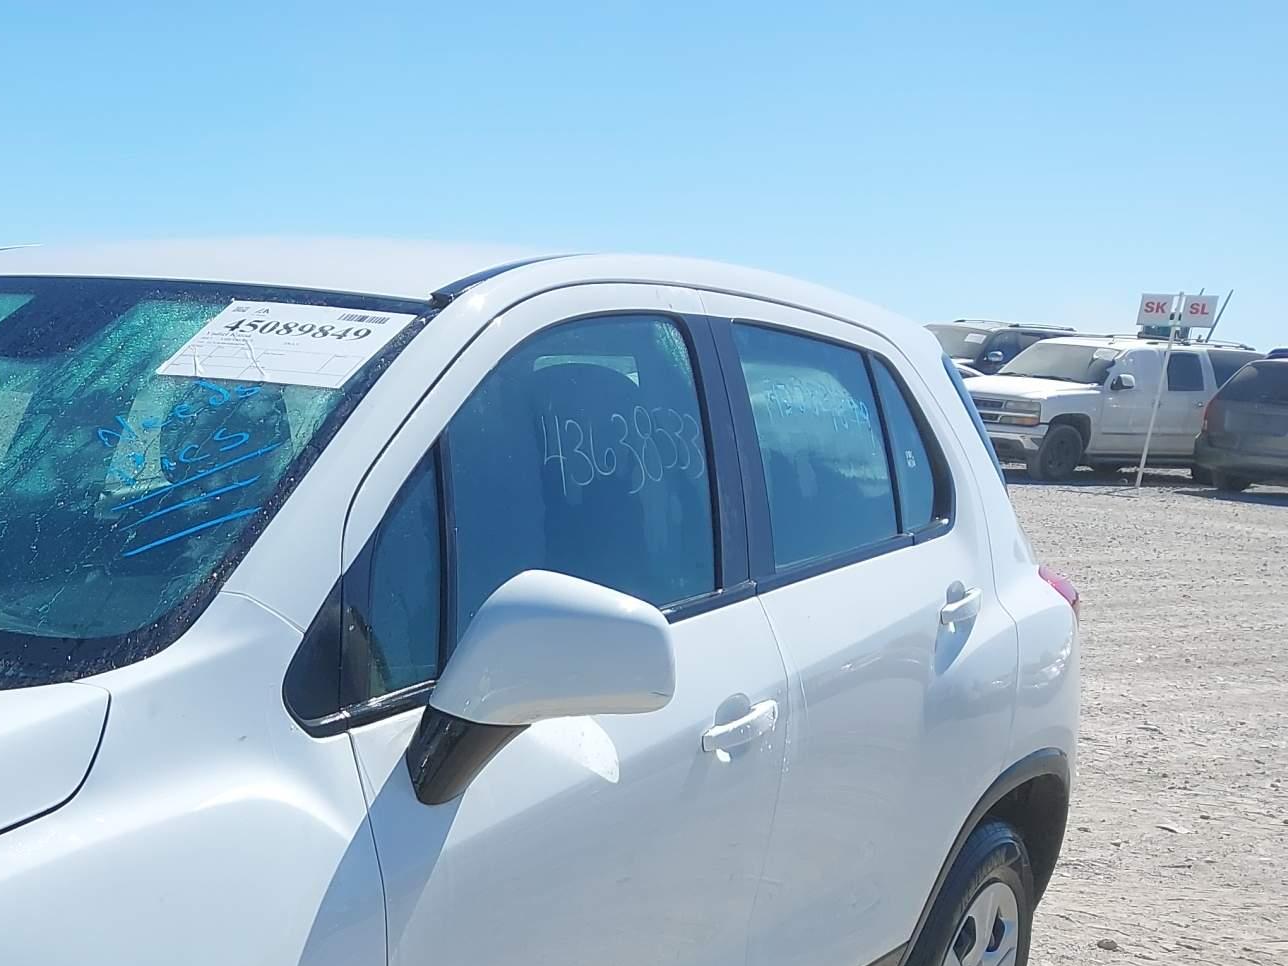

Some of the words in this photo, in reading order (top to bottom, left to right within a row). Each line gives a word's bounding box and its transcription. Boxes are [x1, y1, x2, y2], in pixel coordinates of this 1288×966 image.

[1144, 301, 1168, 314] SK
[1189, 302, 1210, 316] SL
[223, 318, 373, 341] 45089849
[540, 405, 706, 497] 43638533
